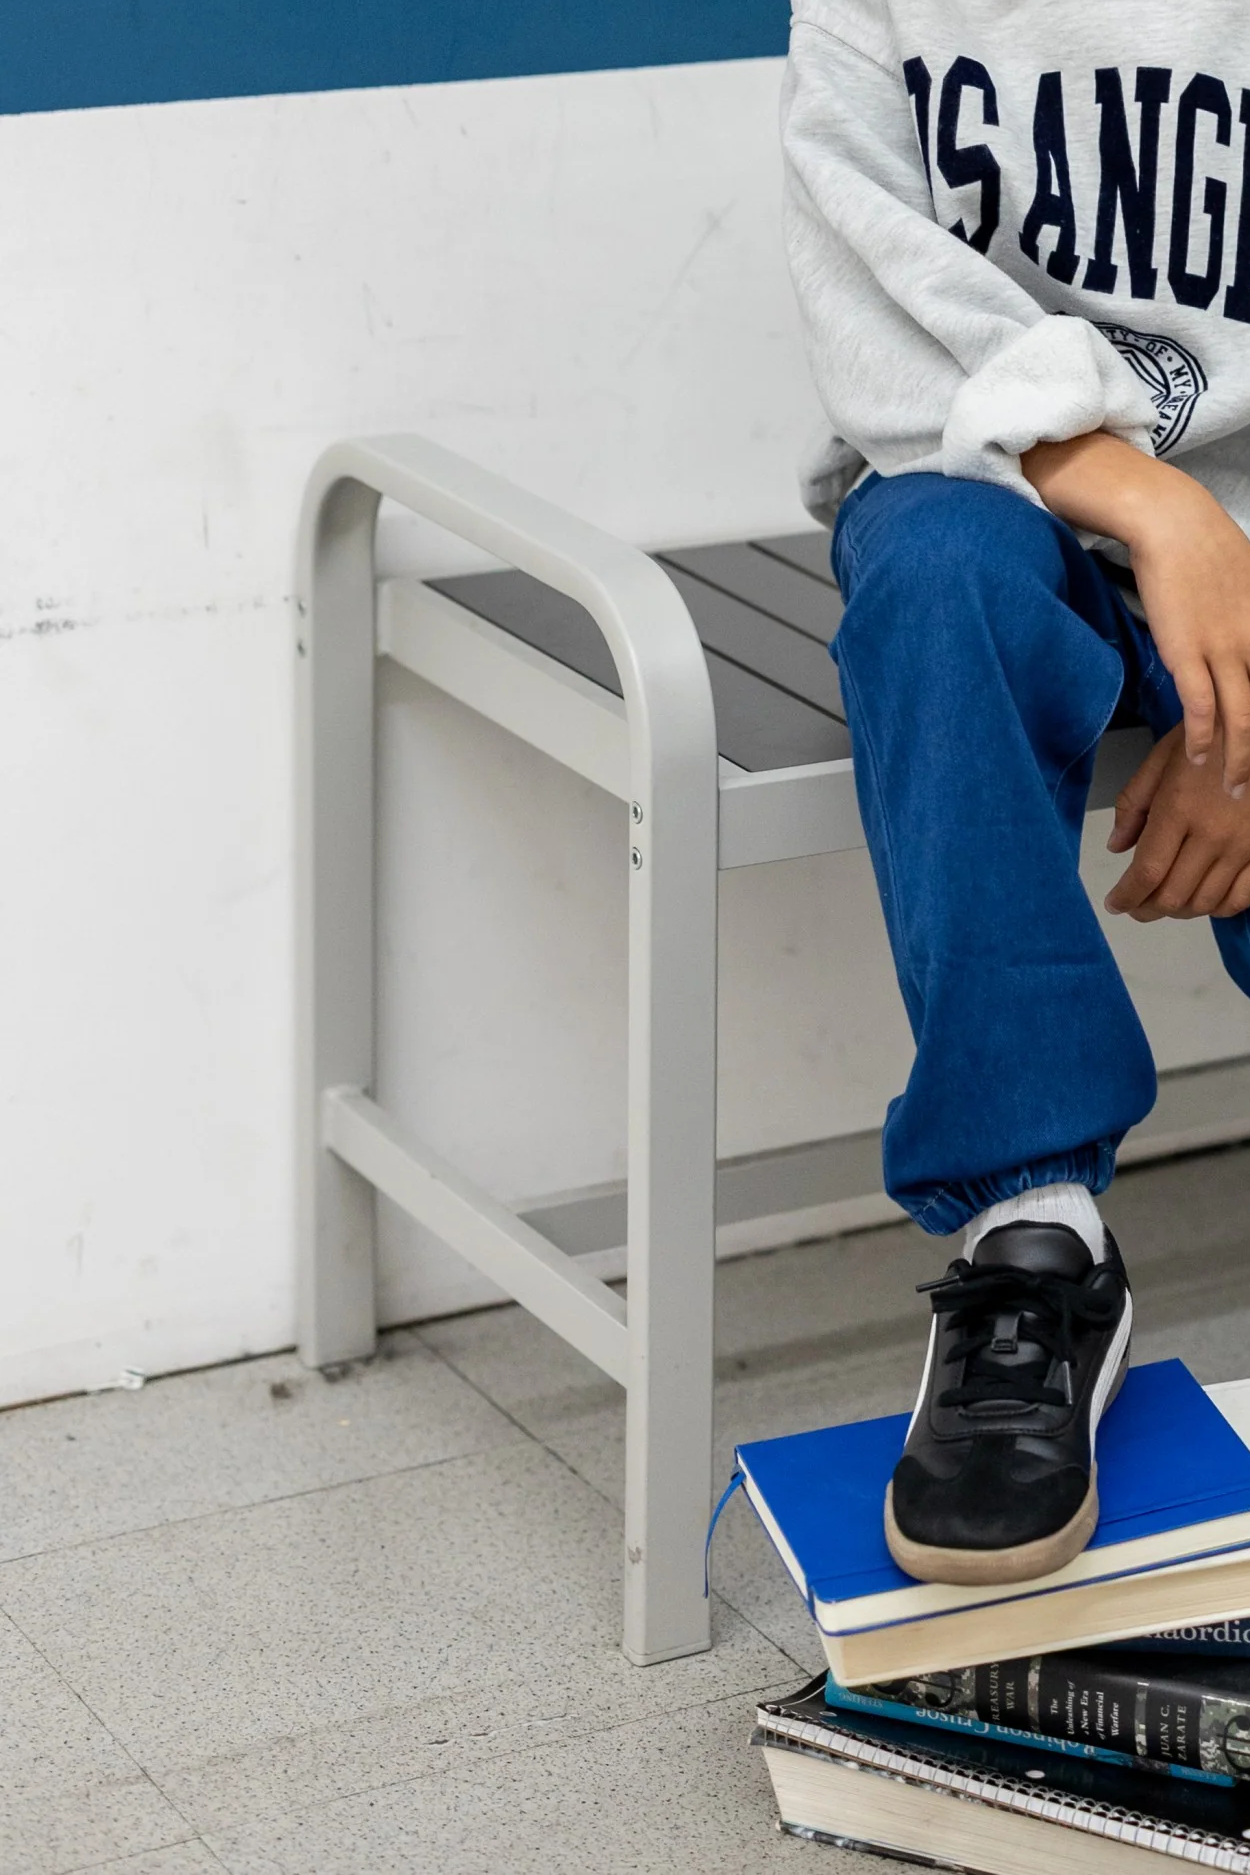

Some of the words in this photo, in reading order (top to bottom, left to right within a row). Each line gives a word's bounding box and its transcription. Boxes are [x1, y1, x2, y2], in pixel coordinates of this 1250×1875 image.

[1145, 341, 1168, 358] OF
[1169, 364, 1193, 391] MY
[989, 1661, 1001, 1727] REASURY
[1006, 1681, 1016, 1711] WAR
[1050, 1697, 1059, 1715] The
[1080, 1689, 1090, 1706] Era
[1096, 1690, 1106, 1731] Financial
[1161, 1703, 1171, 1719] C.
[1066, 1691, 1076, 1736] Unleashing
[1080, 1706, 1090, 1729] New
[1111, 1701, 1121, 1737] Warfare
[1158, 1722, 1171, 1758] JUAN
[1176, 1704, 1188, 1762] ZARATE
